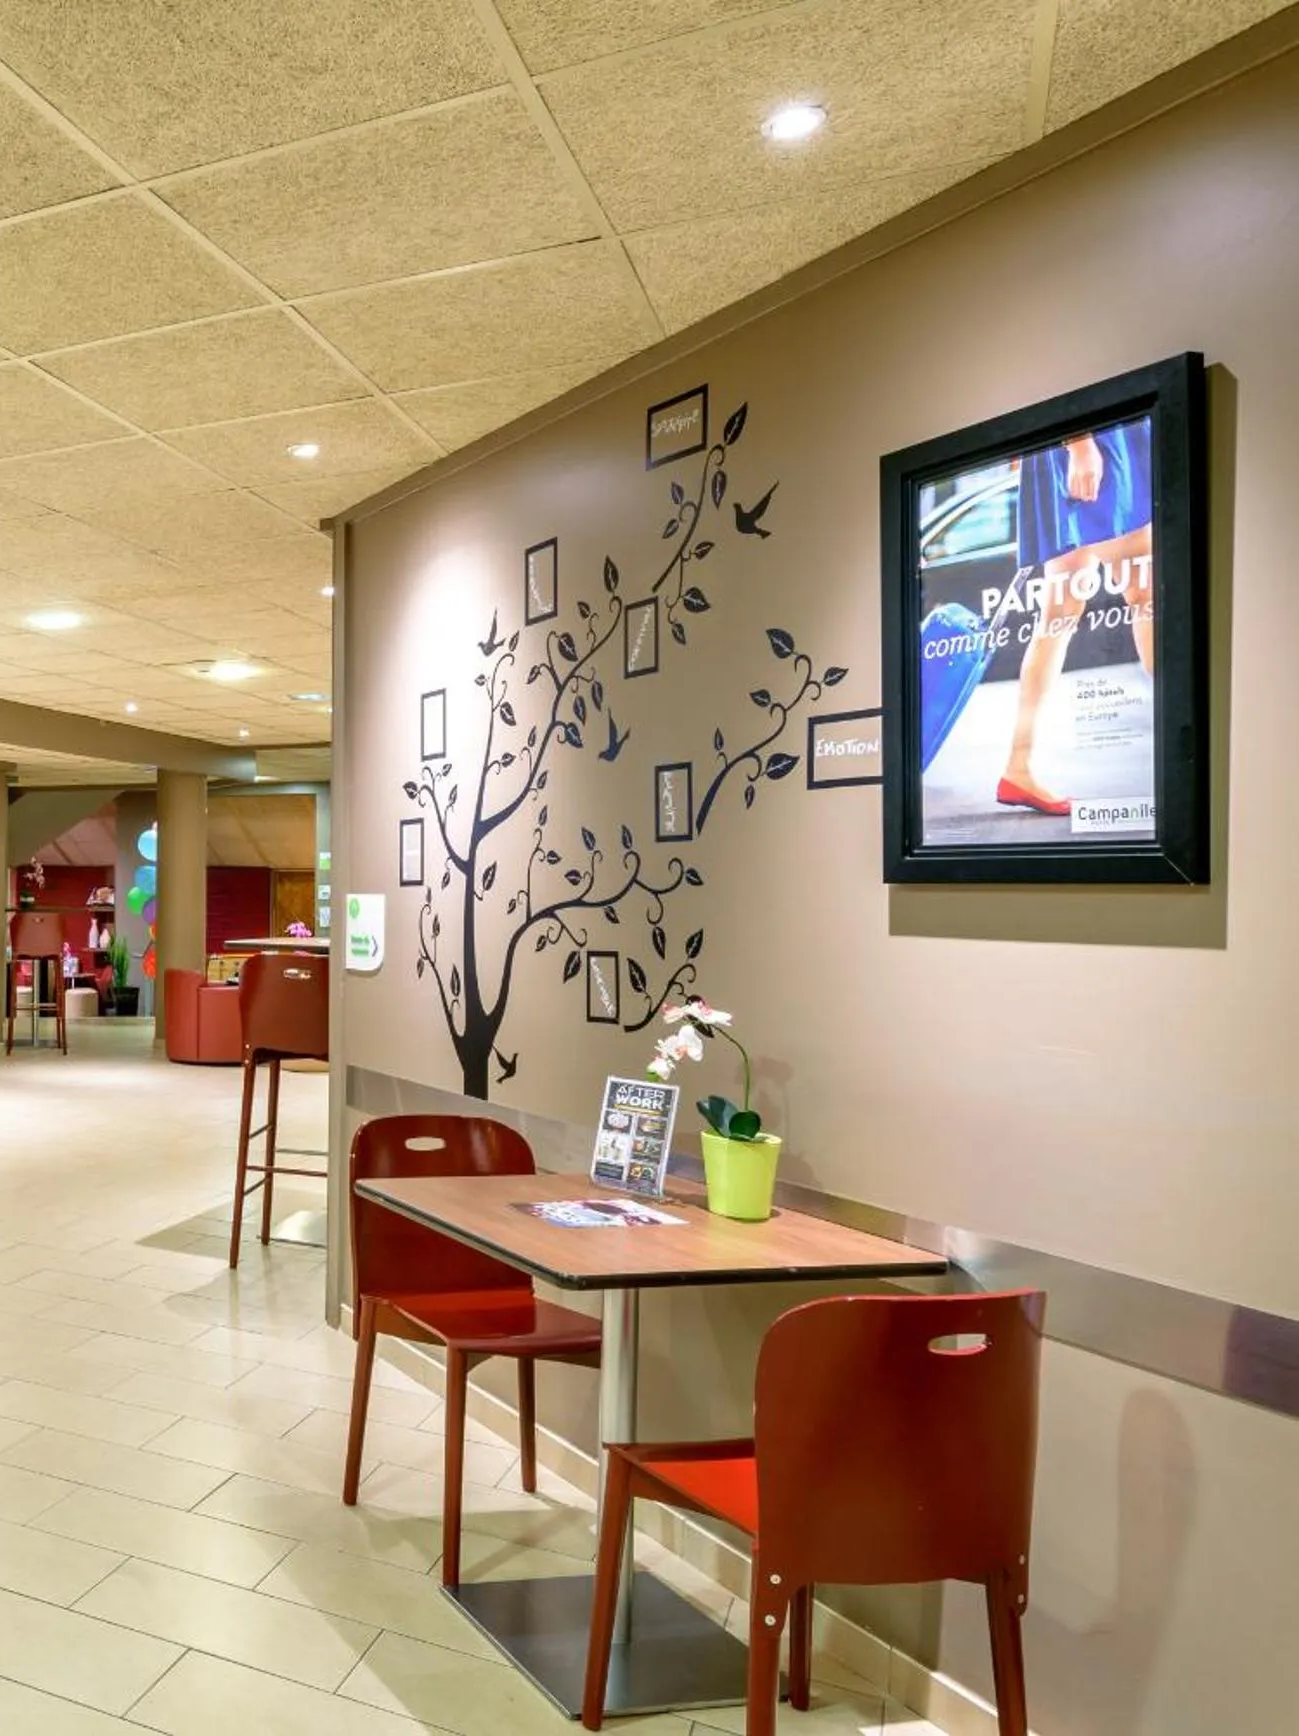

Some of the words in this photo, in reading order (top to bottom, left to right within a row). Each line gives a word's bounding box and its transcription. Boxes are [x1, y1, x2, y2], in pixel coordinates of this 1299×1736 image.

[982, 556, 1153, 619] PARTOUT
[924, 627, 1009, 659] comme
[1018, 612, 1079, 643] chez
[1087, 601, 1154, 631] vous
[1078, 804, 1157, 823] Campanile
[617, 1084, 665, 1099] AFTER
[615, 1094, 664, 1110] WORK
